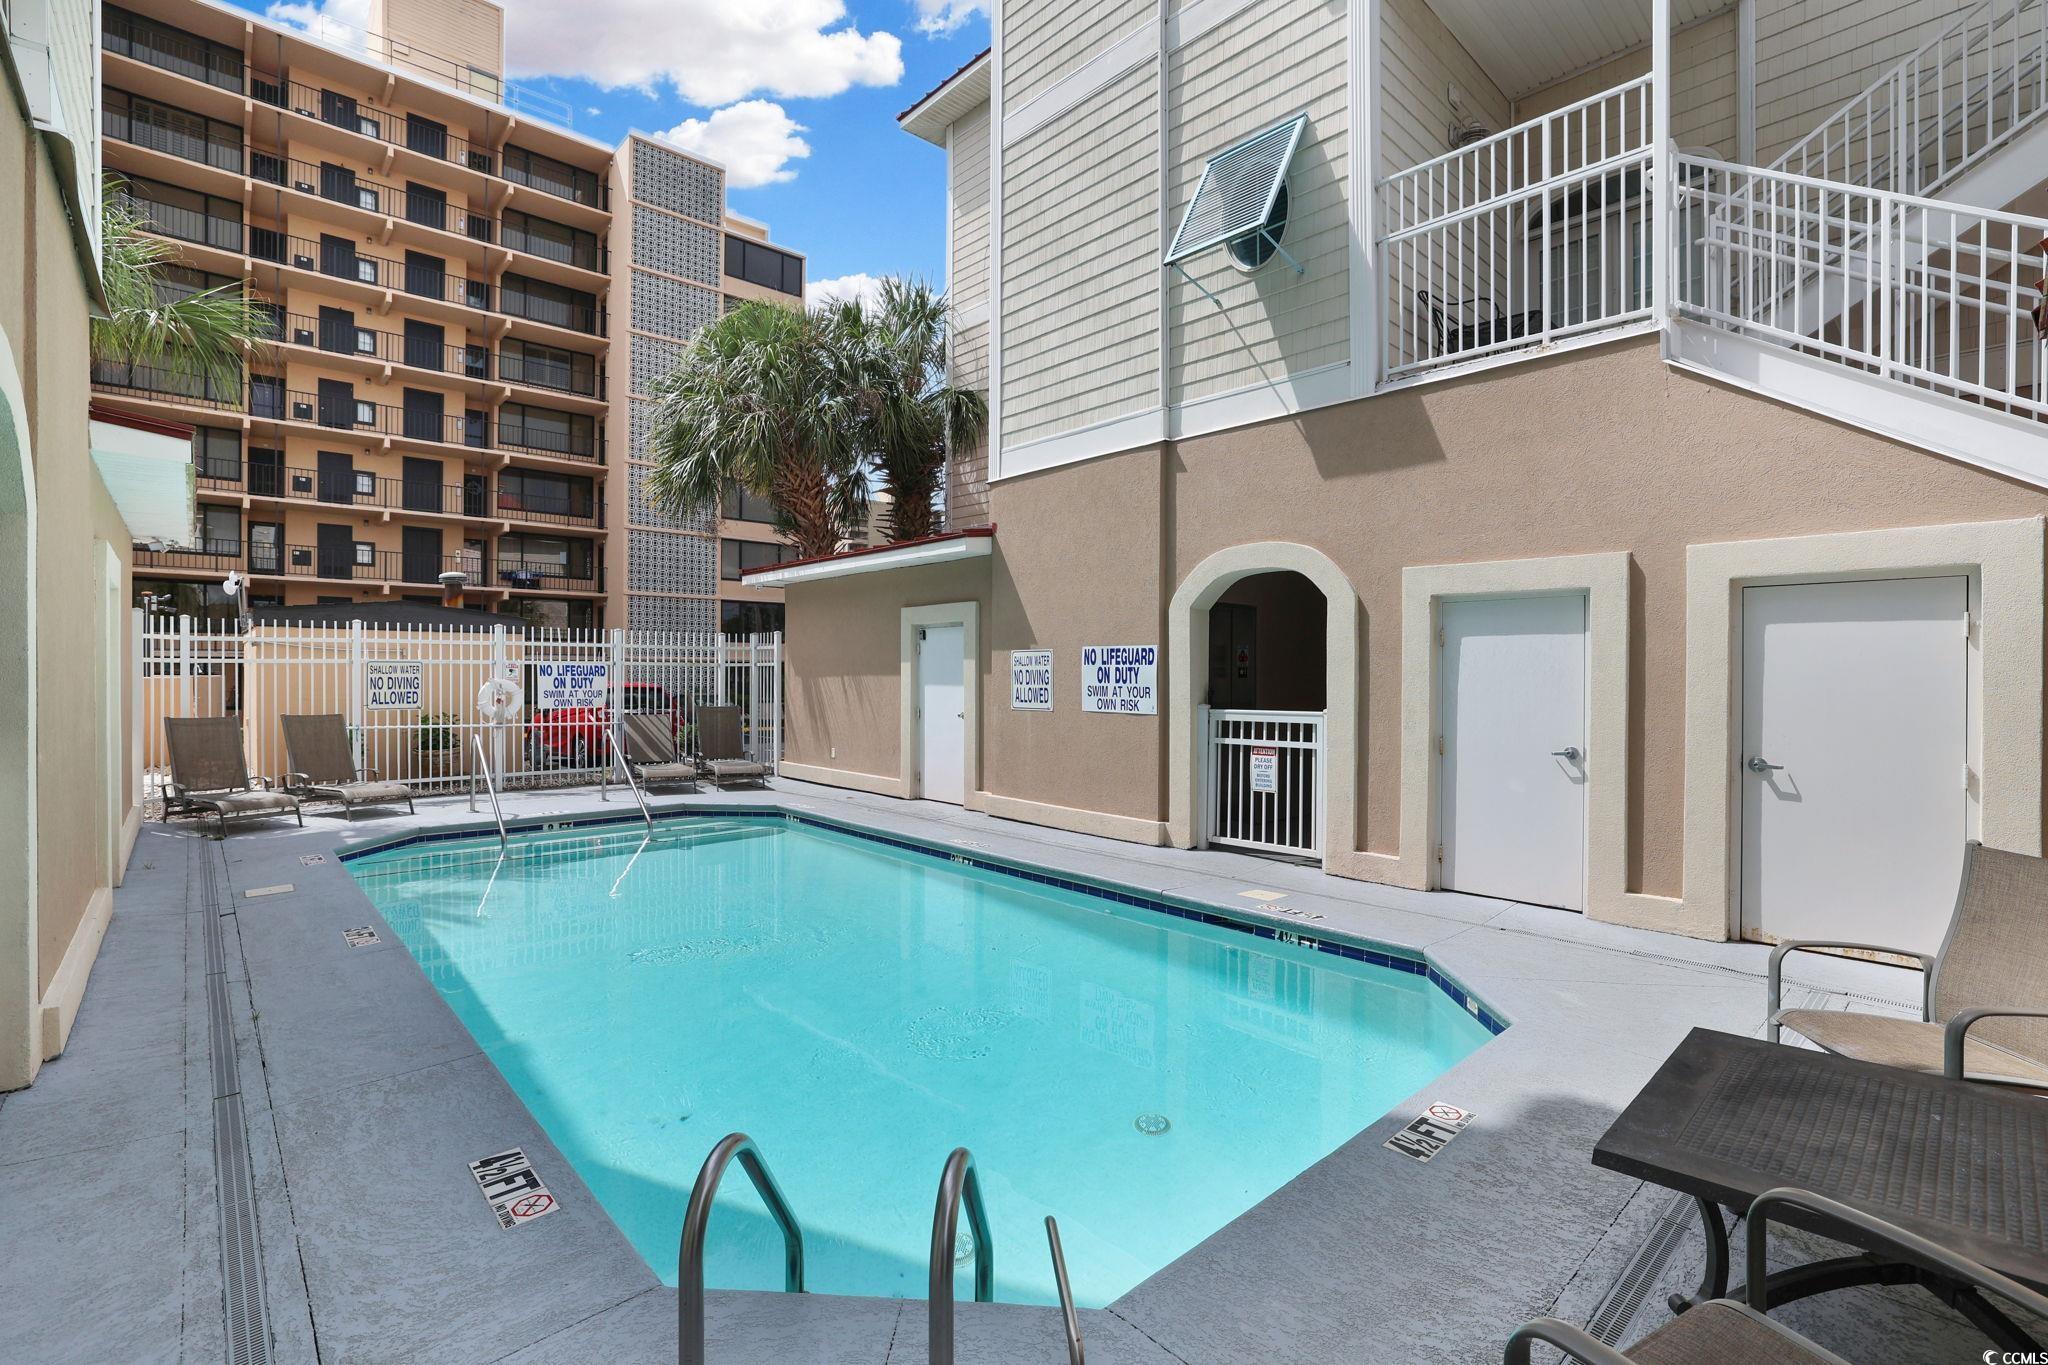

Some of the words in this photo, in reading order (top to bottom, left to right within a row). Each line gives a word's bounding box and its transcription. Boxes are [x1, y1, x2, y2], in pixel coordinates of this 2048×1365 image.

[1014, 656, 1033, 667] SHALLOW
[1033, 655, 1050, 667] WATER
[1084, 648, 1097, 666] NO
[1101, 647, 1155, 666] LIFEGUARD
[369, 665, 398, 675] SHALLOW
[400, 665, 420, 675] WATER
[539, 664, 553, 677] NO
[557, 664, 606, 677] LIFEGUARD
[1097, 667, 1110, 684] ON
[1115, 667, 1140, 684] DUTY
[369, 677, 385, 690] NO
[387, 677, 420, 690] DIVING
[553, 677, 567, 689] ON
[571, 677, 594, 689] DUTY
[1014, 670, 1024, 686] NO
[1025, 669, 1050, 686] DIVING
[371, 690, 419, 705] ALLOWED
[543, 689, 566, 699] SWIM
[569, 689, 580, 699] AT
[582, 689, 603, 699] YOUR
[1015, 687, 1049, 704] ALLOWED
[1087, 685, 1109, 698] SWIM
[1112, 686, 1122, 698] AT
[1127, 687, 1151, 699] YOUR
[554, 698, 573, 707] OWN
[577, 698, 594, 707] RISK
[1097, 699, 1117, 711] OWN
[1120, 699, 1140, 711] RISK
[1406, 1116, 1457, 1144] FT
[482, 1168, 541, 1201] FT
